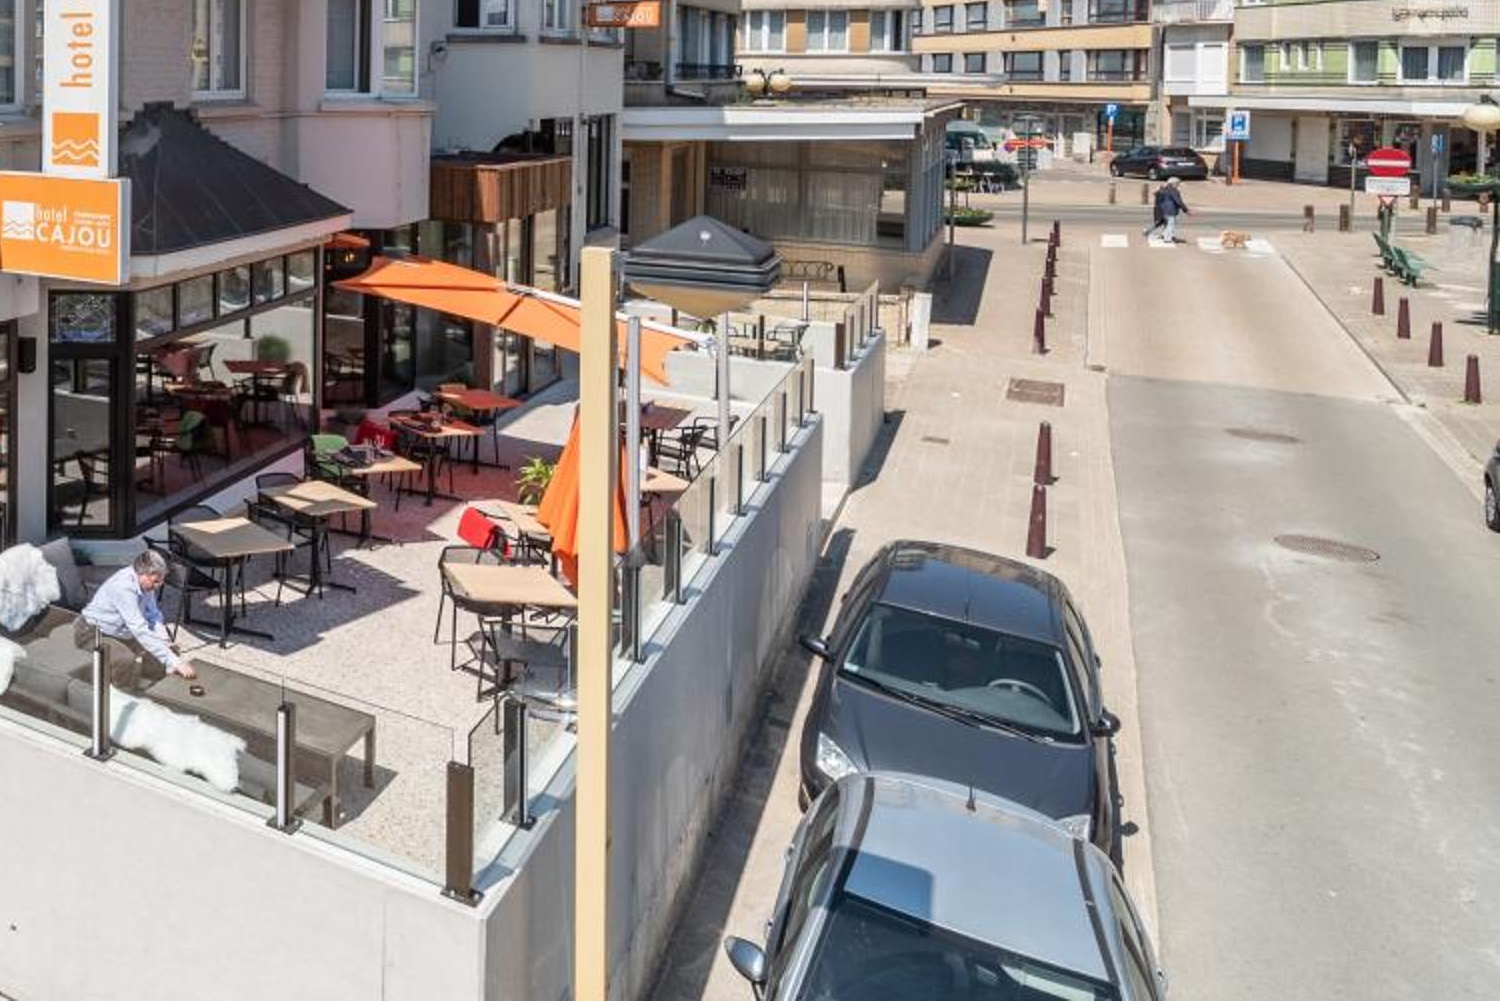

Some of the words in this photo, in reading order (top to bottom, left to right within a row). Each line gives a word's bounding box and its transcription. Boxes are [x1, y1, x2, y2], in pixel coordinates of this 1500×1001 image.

[60, 6, 94, 89] hotel
[35, 203, 68, 222] hotel
[35, 221, 111, 248] CAJOU
